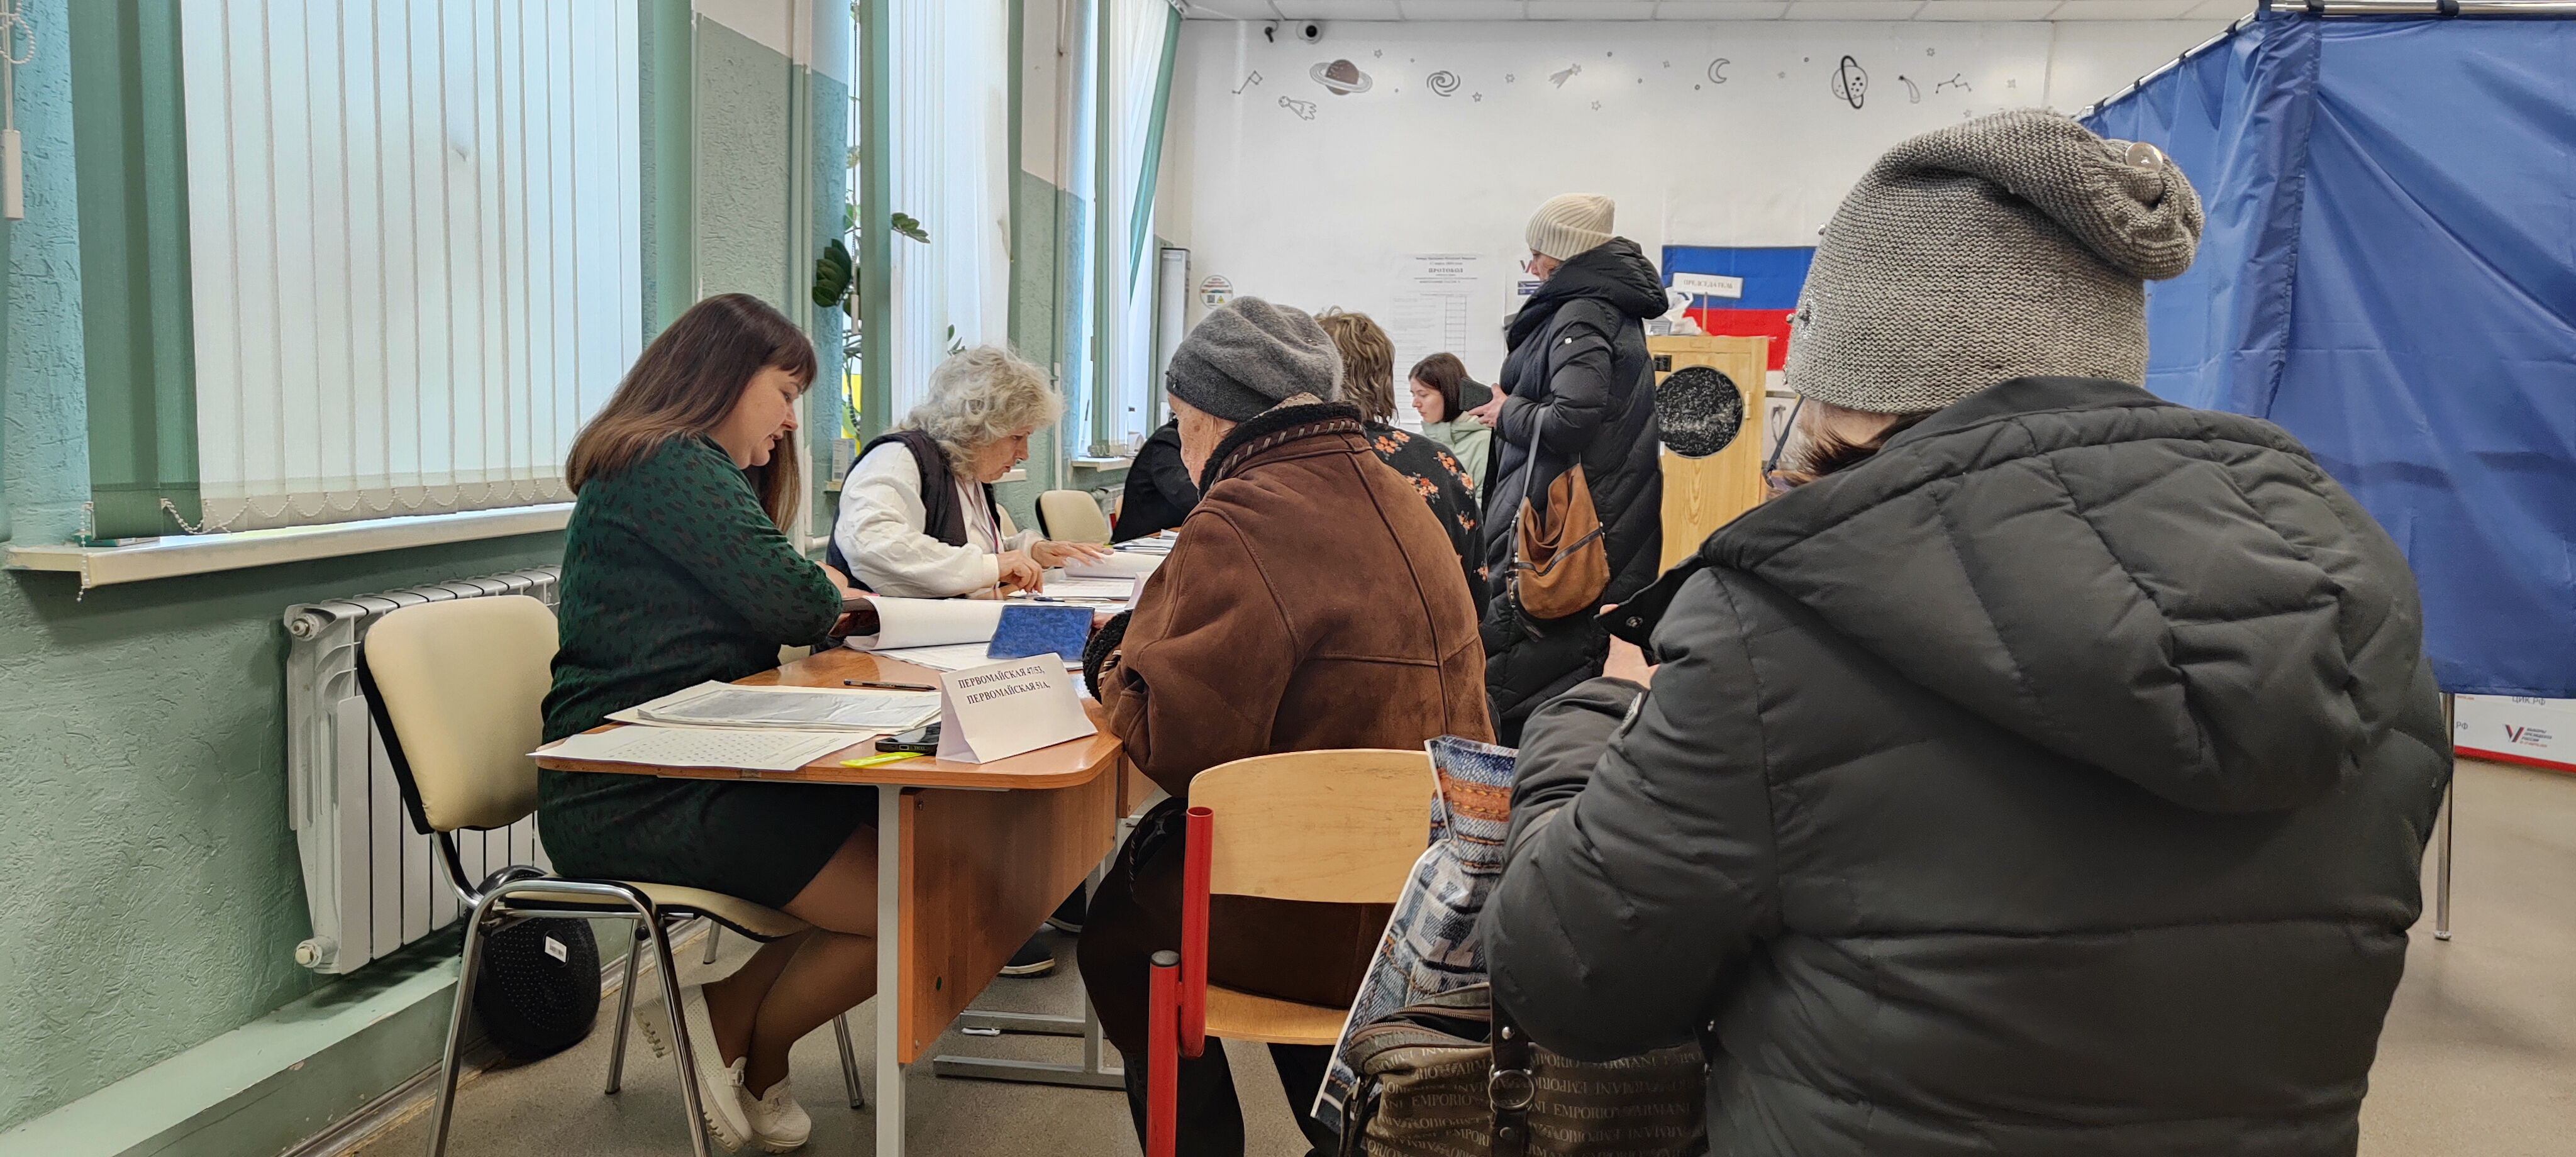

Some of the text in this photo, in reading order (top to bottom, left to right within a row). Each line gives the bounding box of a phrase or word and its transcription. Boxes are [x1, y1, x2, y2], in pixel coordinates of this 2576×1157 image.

[1684, 279, 1733, 289] ПРЕДСЕДАТЕЛЬ
[958, 668, 1026, 689] ПЕРВОМАЙСКАЯ
[967, 682, 1036, 704] ПЕРВОМАЙСКАЯ
[1529, 1053, 1580, 1068] MPORIO
[1412, 1093, 1472, 1107] EMPORIO
[1554, 1103, 1614, 1119] EMPORIO
[1446, 1129, 1491, 1146] EMPORI
